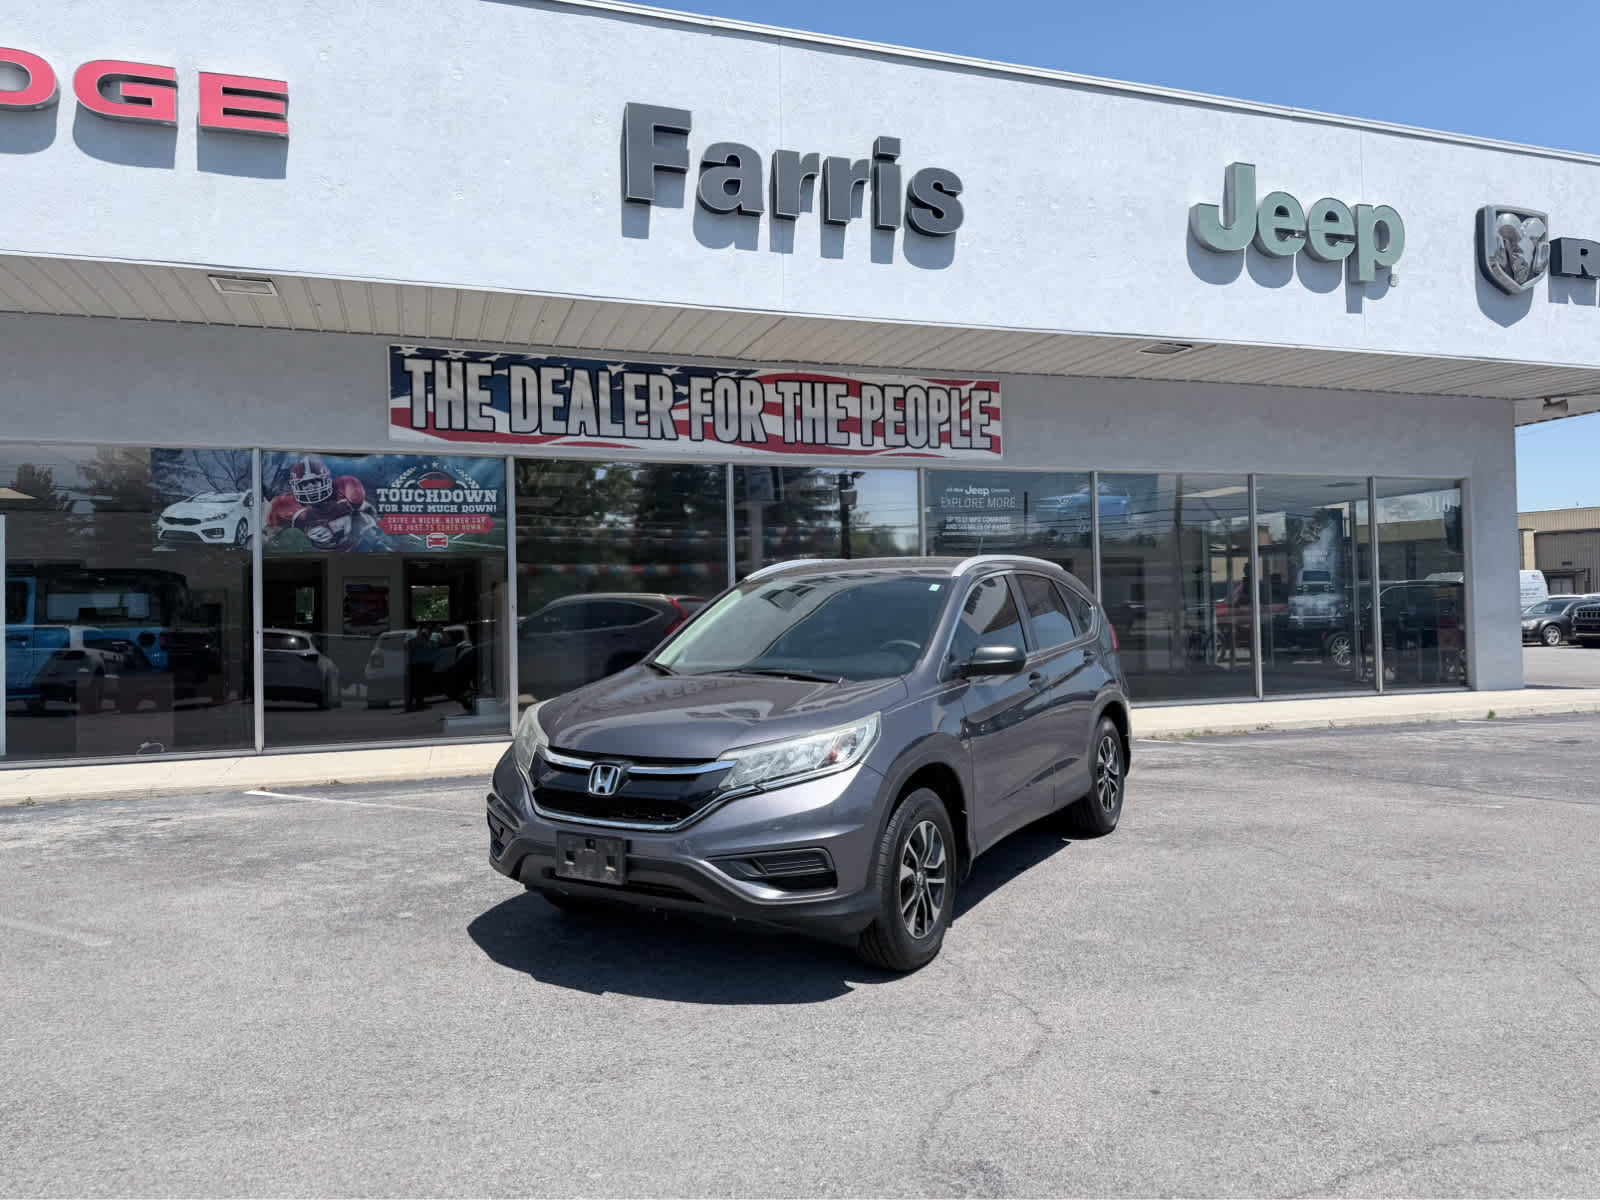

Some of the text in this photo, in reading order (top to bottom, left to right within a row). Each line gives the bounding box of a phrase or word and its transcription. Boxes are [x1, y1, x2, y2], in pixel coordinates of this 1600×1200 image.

[620, 102, 964, 237] Farris
[1189, 162, 1405, 283] Jeep
[403, 358, 992, 449] THE DEALER FOR THE PEOPLE
[376, 488, 497, 503] TOUCHDOWN
[965, 485, 990, 496] Jeep
[378, 504, 497, 513] FOR NOT MUCH DOWN!
[941, 497, 1016, 509] EXPLORE MORE
